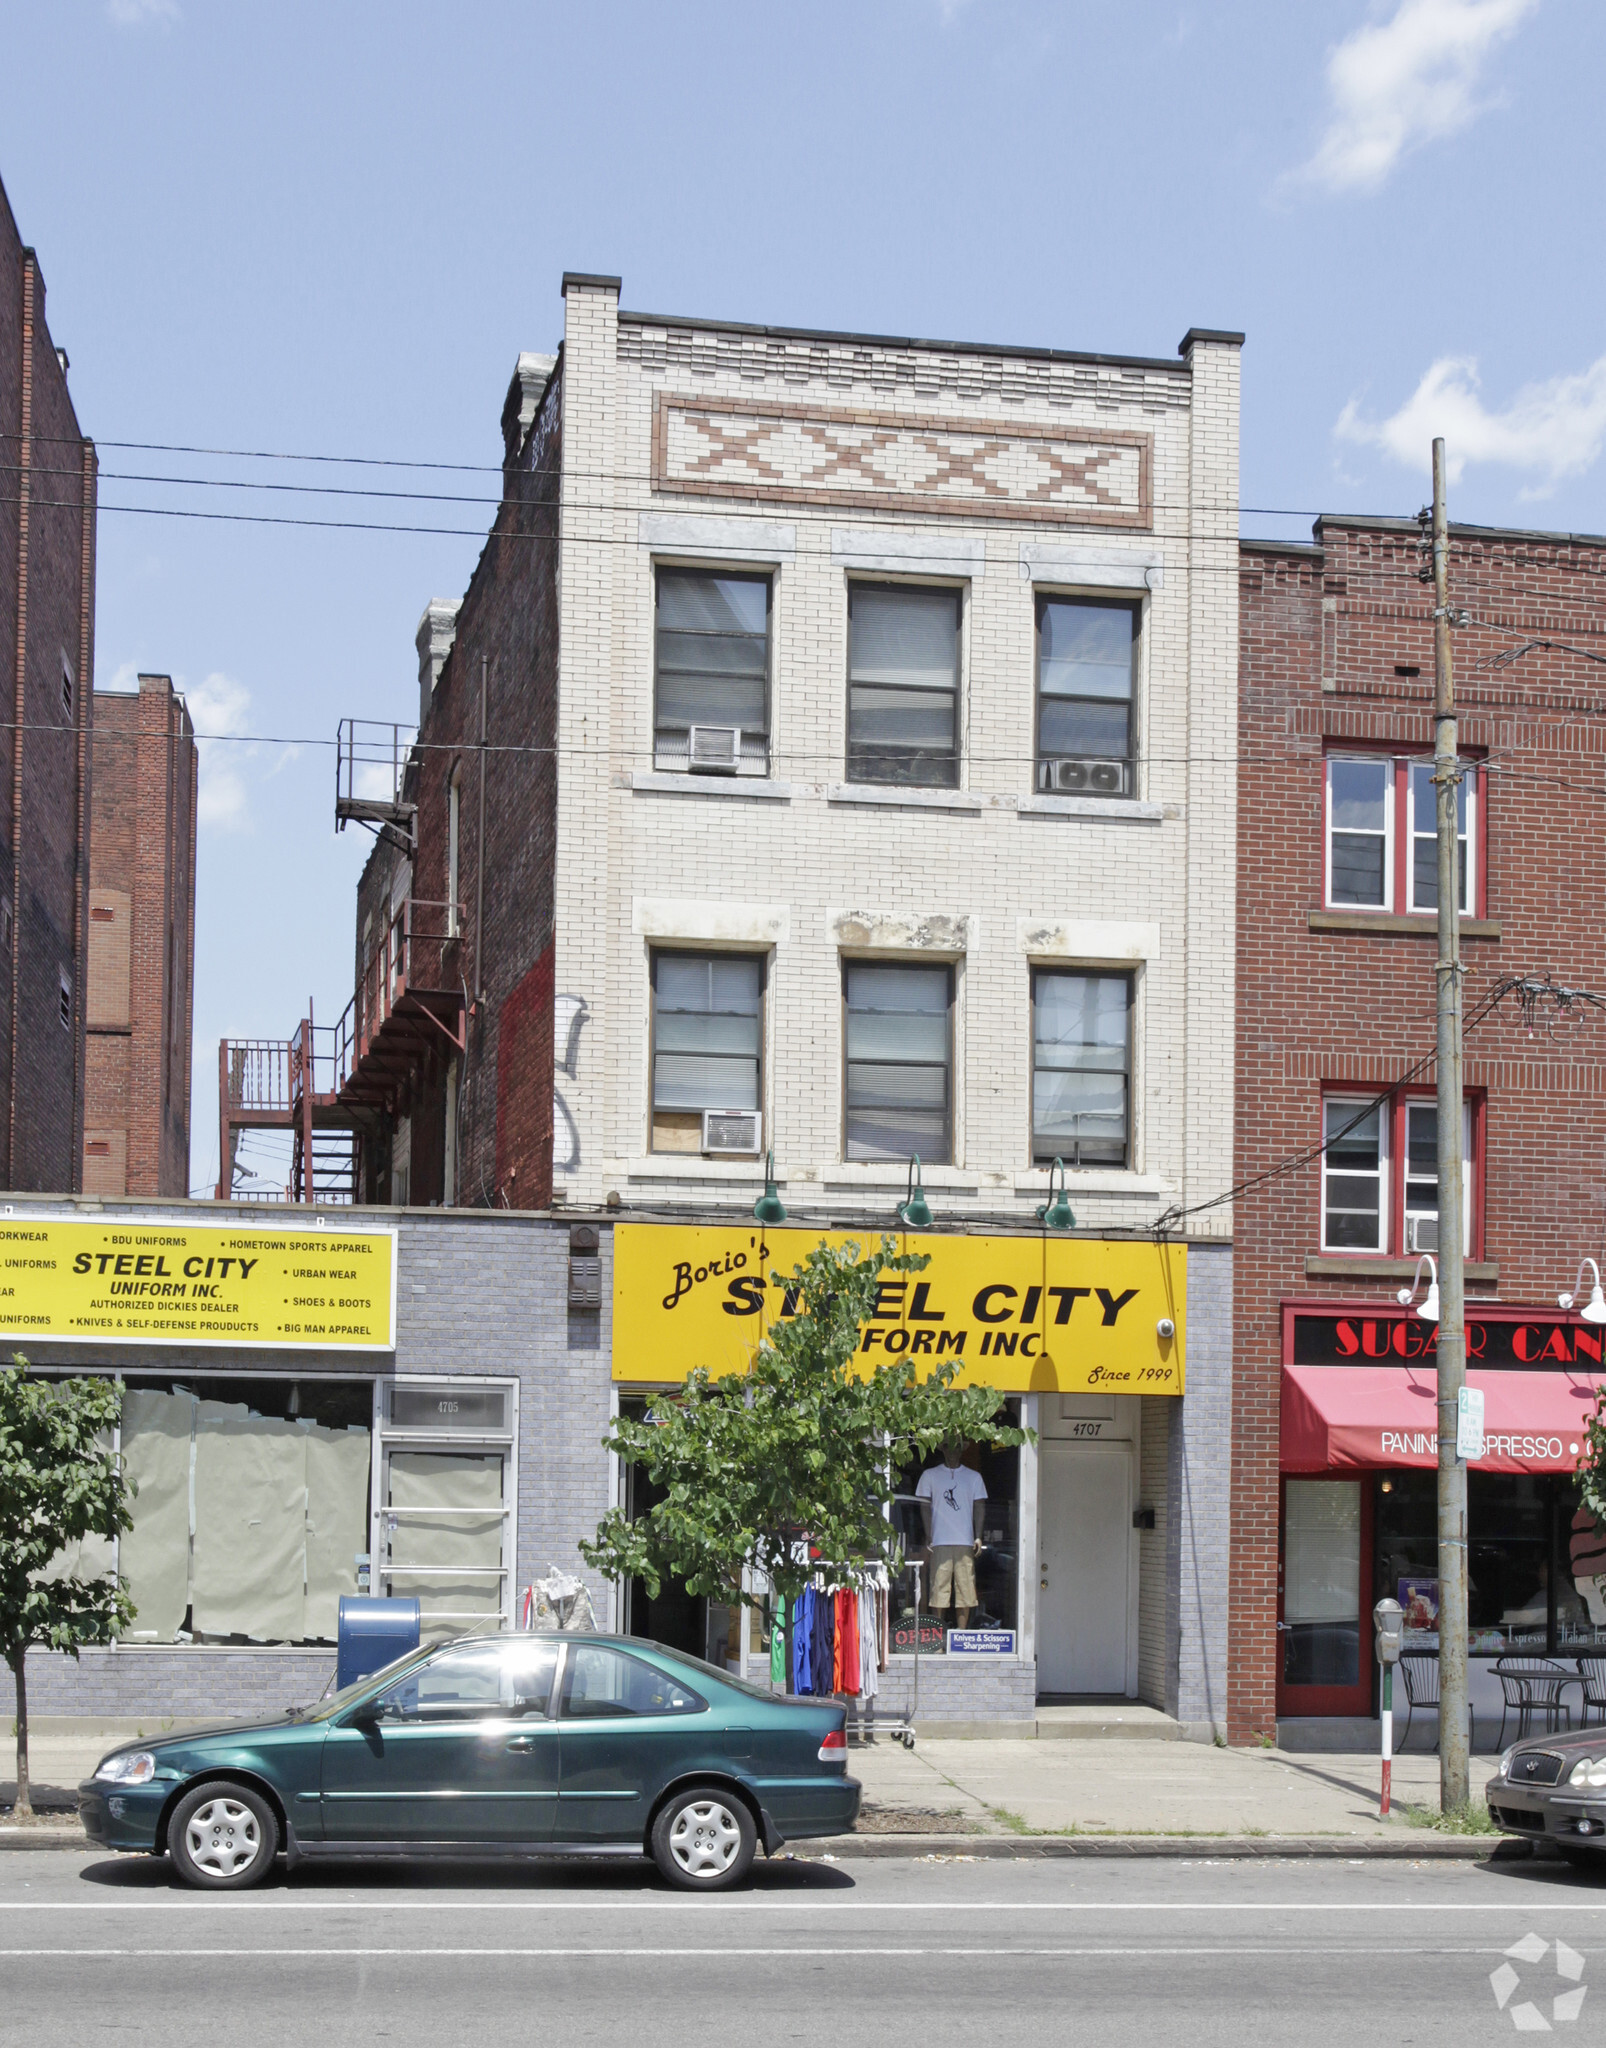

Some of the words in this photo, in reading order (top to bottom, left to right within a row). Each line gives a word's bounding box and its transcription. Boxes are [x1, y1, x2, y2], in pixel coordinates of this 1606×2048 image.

[111, 1235, 133, 1245] BDU
[135, 1236, 187, 1247] UNIFORMS
[229, 1239, 286, 1250] HOMETOWN
[289, 1241, 328, 1252] SPORTS
[329, 1243, 373, 1254] APPAREL
[4, 1259, 57, 1270] UNIFORMS
[72, 1252, 172, 1277] STEEL
[182, 1256, 259, 1280] CITY
[292, 1268, 327, 1279] URBAN
[328, 1270, 357, 1280] WEAR
[660, 1234, 772, 1312] Borio's
[0, 1287, 15, 1297] AR
[110, 1281, 187, 1297] UNIFORM
[191, 1283, 223, 1299] INC.
[90, 1299, 155, 1310] AUTHORIZED
[157, 1301, 198, 1312] DICKIES
[200, 1302, 239, 1313] DEALER
[293, 1296, 326, 1307] SHOES
[328, 1298, 336, 1307] &
[338, 1298, 371, 1309] BOOTS
[722, 1276, 946, 1322] STEL
[972, 1284, 1140, 1328] CITY
[0, 1315, 51, 1325] UNIFORMS
[76, 1317, 113, 1327] KNIVES
[116, 1318, 123, 1328] &
[126, 1319, 197, 1330] SELF-DEFENSE
[199, 1321, 259, 1332] PROUDUCTS
[284, 1323, 301, 1333] BIG
[304, 1324, 326, 1334] MAN
[328, 1325, 372, 1335] APPAREL
[853, 1327, 968, 1356] FORM
[979, 1331, 1049, 1358] INC.
[1512, 1324, 1606, 1363] CAN
[1087, 1365, 1131, 1385] Since
[1136, 1367, 1173, 1382] 1999
[437, 1401, 459, 1413] 4705
[1073, 1423, 1102, 1436] 4707
[1481, 1435, 1563, 1459] PRESSO
[895, 1627, 943, 1645] OPEN
[953, 1634, 976, 1642] Knives
[976, 1634, 982, 1642] &
[983, 1634, 1010, 1643] Scissors
[1508, 1624, 1546, 1647] Espresso
[1561, 1621, 1587, 1644] Italian
[963, 1642, 1000, 1652] Sharpening
